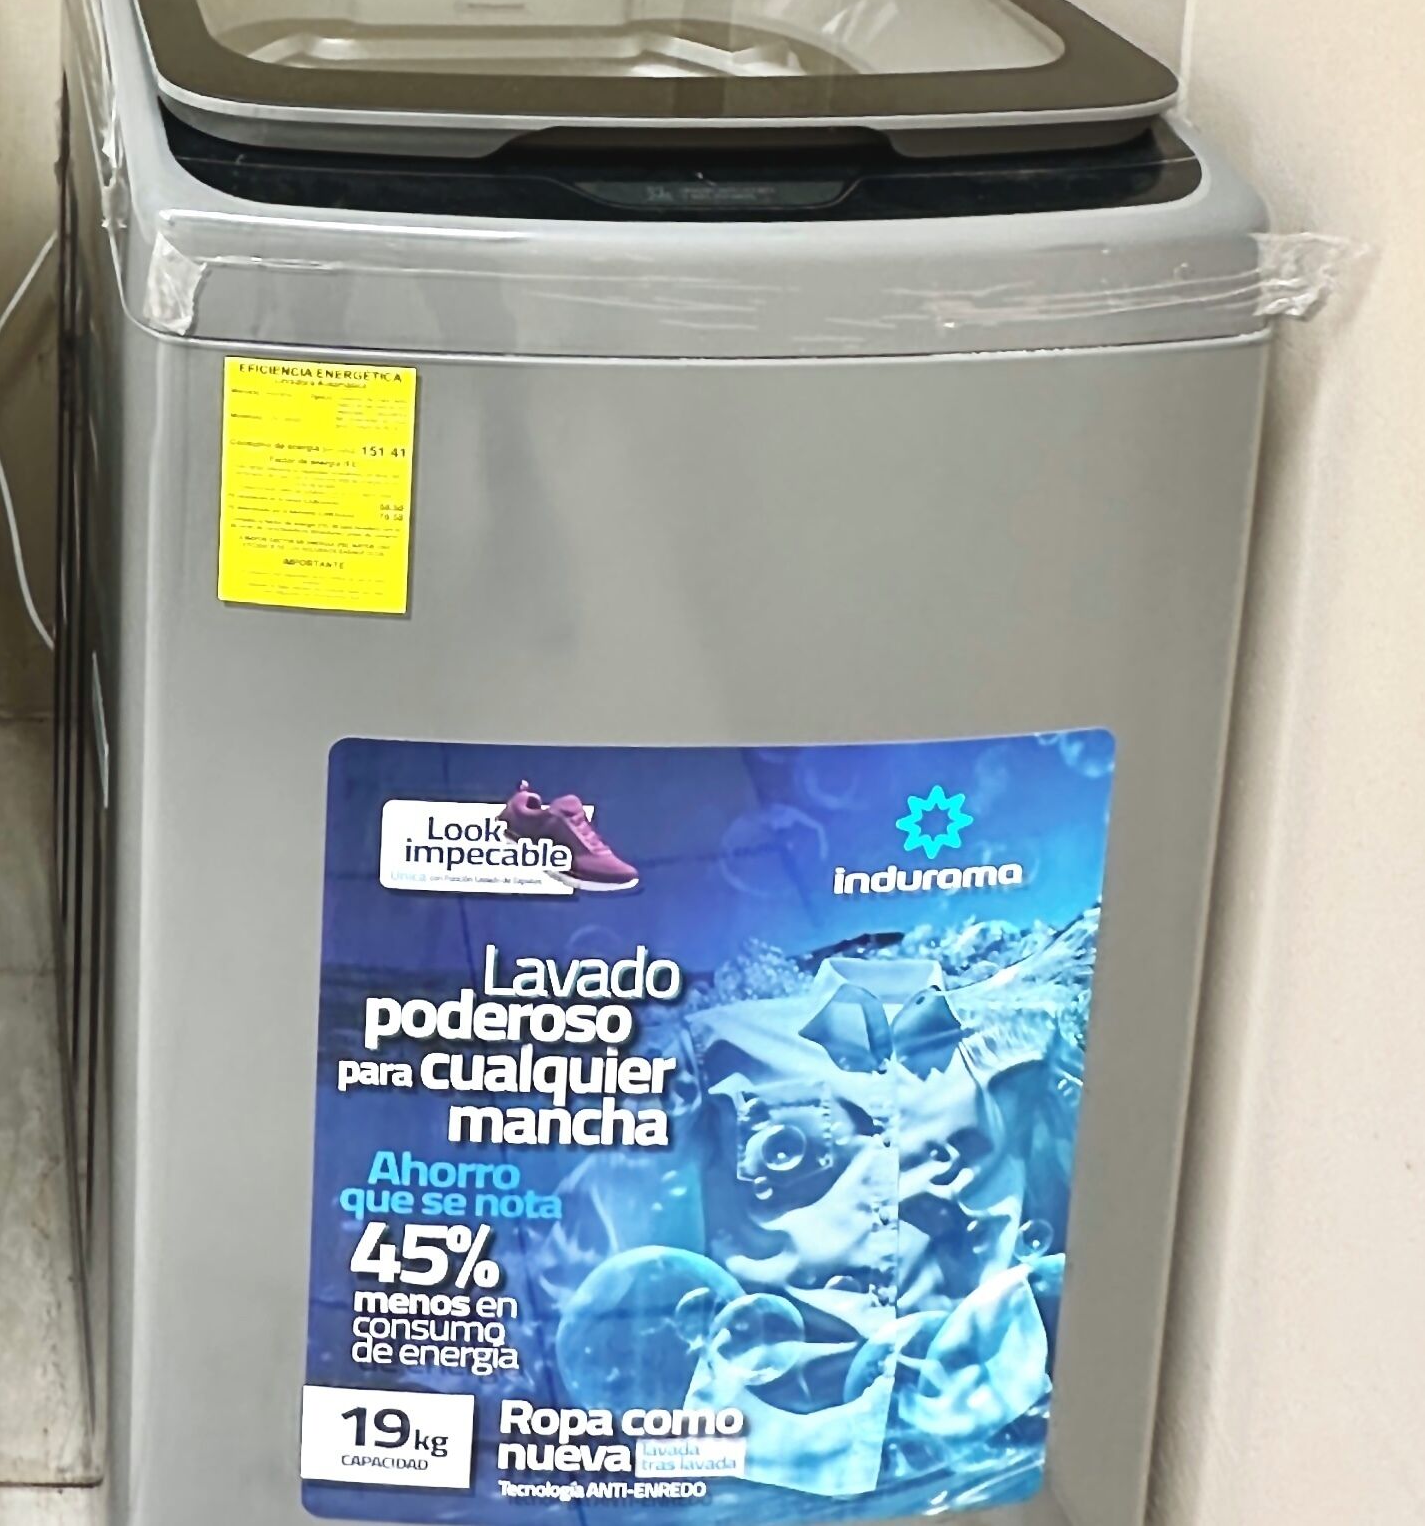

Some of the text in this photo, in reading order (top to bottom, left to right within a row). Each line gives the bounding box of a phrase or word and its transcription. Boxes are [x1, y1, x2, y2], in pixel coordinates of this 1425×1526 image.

[239, 363, 402, 384] EFICIENCIA ENERGÉTICA
[428, 816, 501, 842] Look
[405, 837, 568, 871] impecable
[833, 863, 1023, 895] indurama
[484, 944, 680, 1000] Lavado
[365, 988, 632, 1049] poderoso
[338, 1043, 676, 1106] para cualquier
[448, 1097, 668, 1146] mancha
[367, 1151, 521, 1190] Ahorro
[339, 1187, 562, 1220] que se nota
[350, 1221, 500, 1289] 45%
[353, 1290, 518, 1319] menos en
[353, 1316, 506, 1344] consumo
[352, 1337, 519, 1375] de energía
[499, 1399, 744, 1444] Ropa como
[341, 1454, 429, 1471] CAPACIDAD
[497, 1442, 632, 1472] nueva
[641, 1457, 737, 1471] tras lavada
[642, 1441, 700, 1457] lavada
[497, 1479, 707, 1502] Tecnología ANTI-ENREDO
